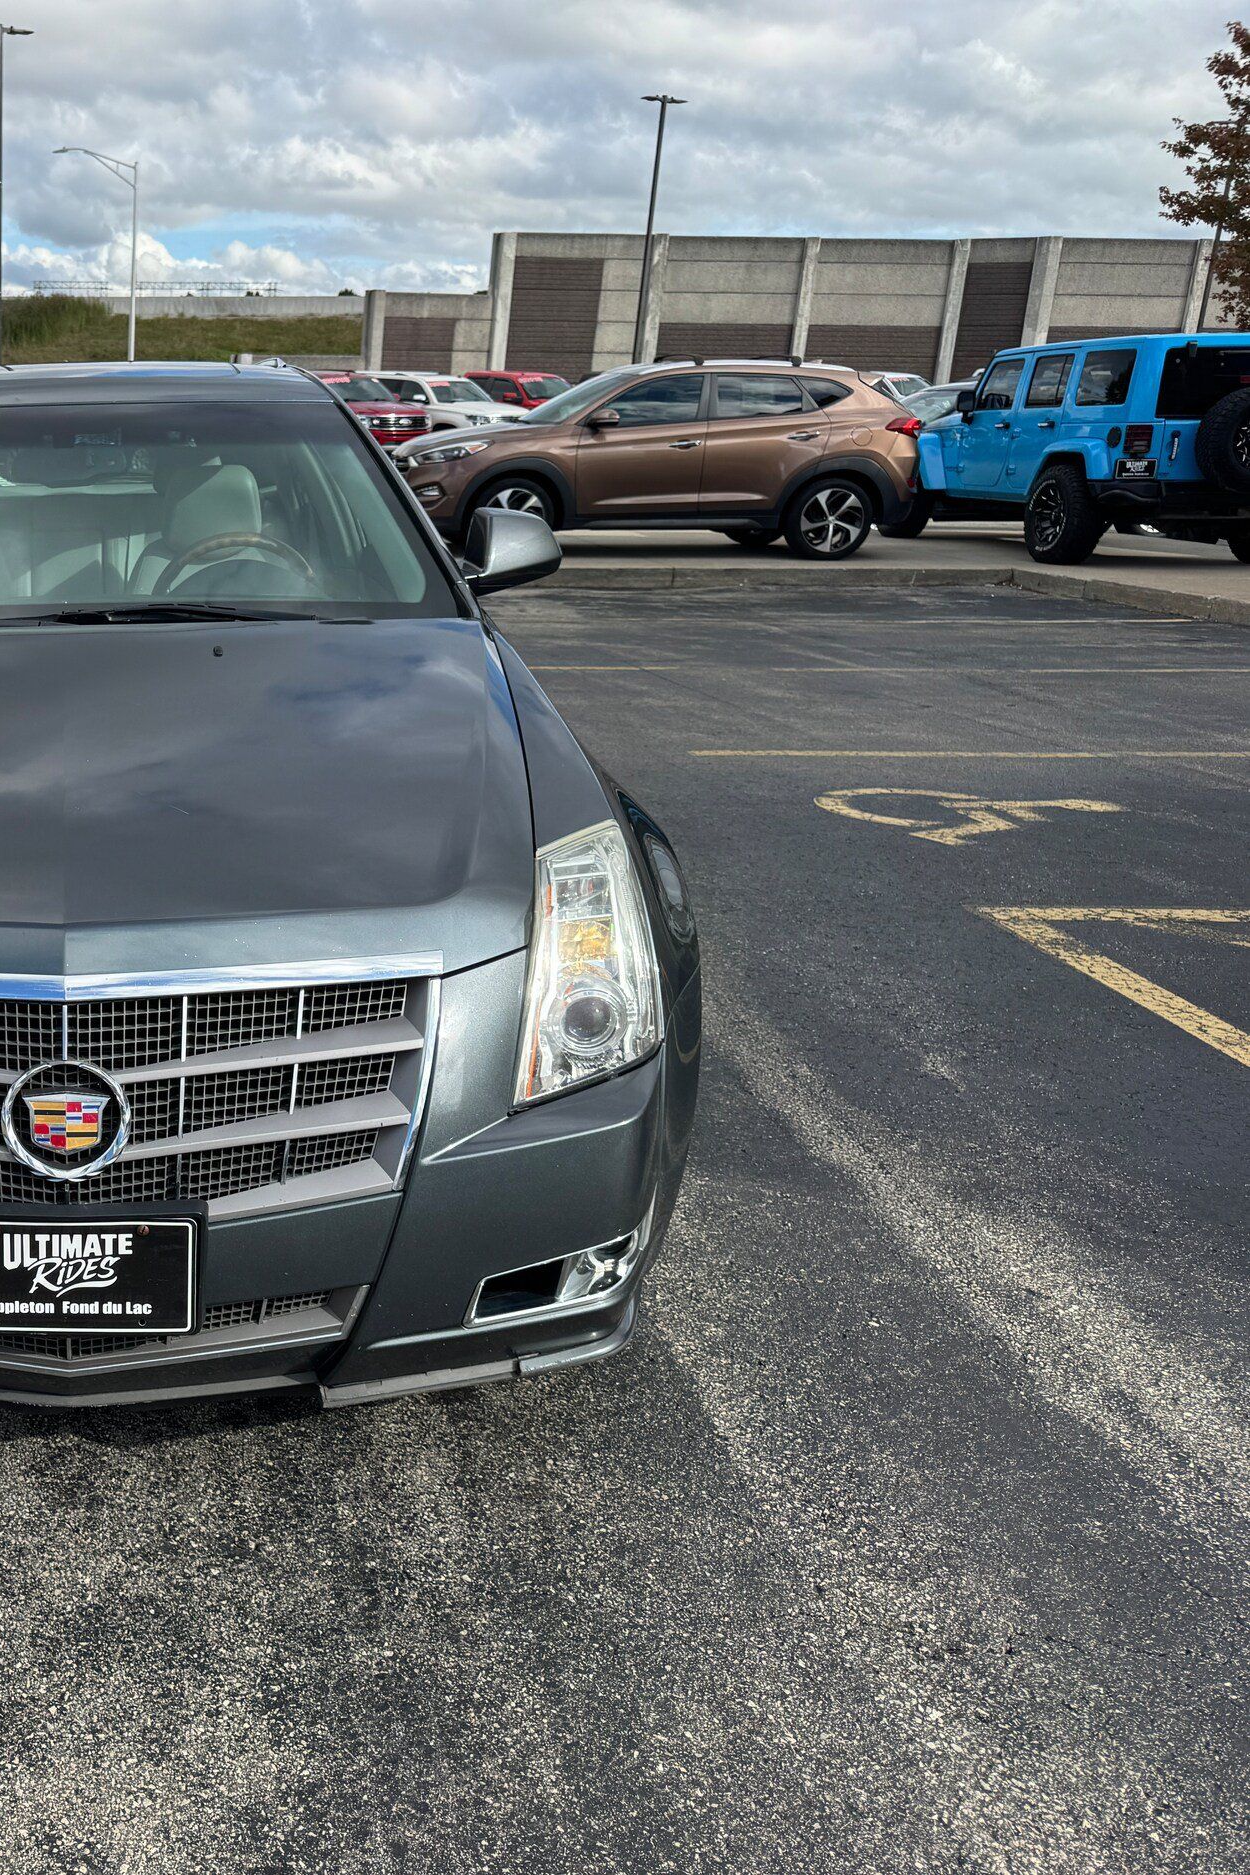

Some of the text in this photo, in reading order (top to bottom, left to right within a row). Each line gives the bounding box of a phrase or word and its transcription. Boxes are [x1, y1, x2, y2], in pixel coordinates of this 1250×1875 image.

[2, 1233, 133, 1271] ULTIMATE
[62, 1300, 99, 1315] Fond
[102, 1300, 121, 1315] du
[125, 1301, 152, 1315] Lac
